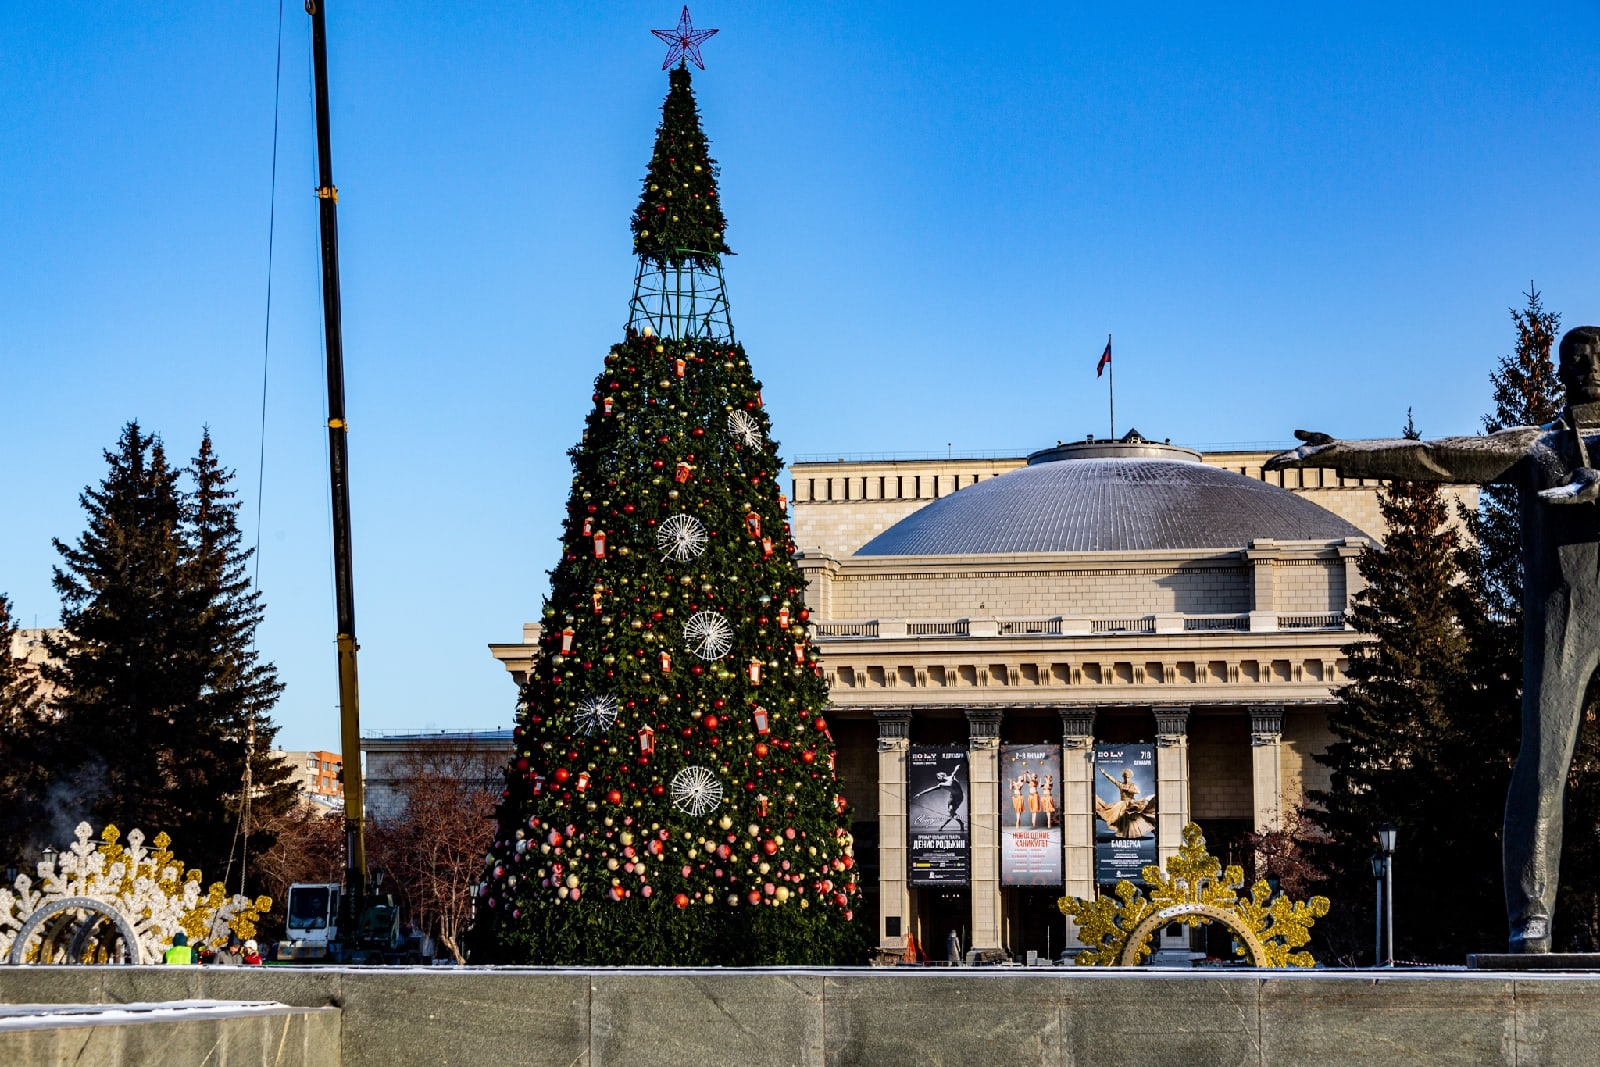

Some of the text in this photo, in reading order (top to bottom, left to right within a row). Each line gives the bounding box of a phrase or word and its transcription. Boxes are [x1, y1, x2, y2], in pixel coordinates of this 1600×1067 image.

[913, 840, 965, 849] ДЕНИС РОДЬКИН
[1015, 839, 1048, 848] КАНИКУЛЫ
